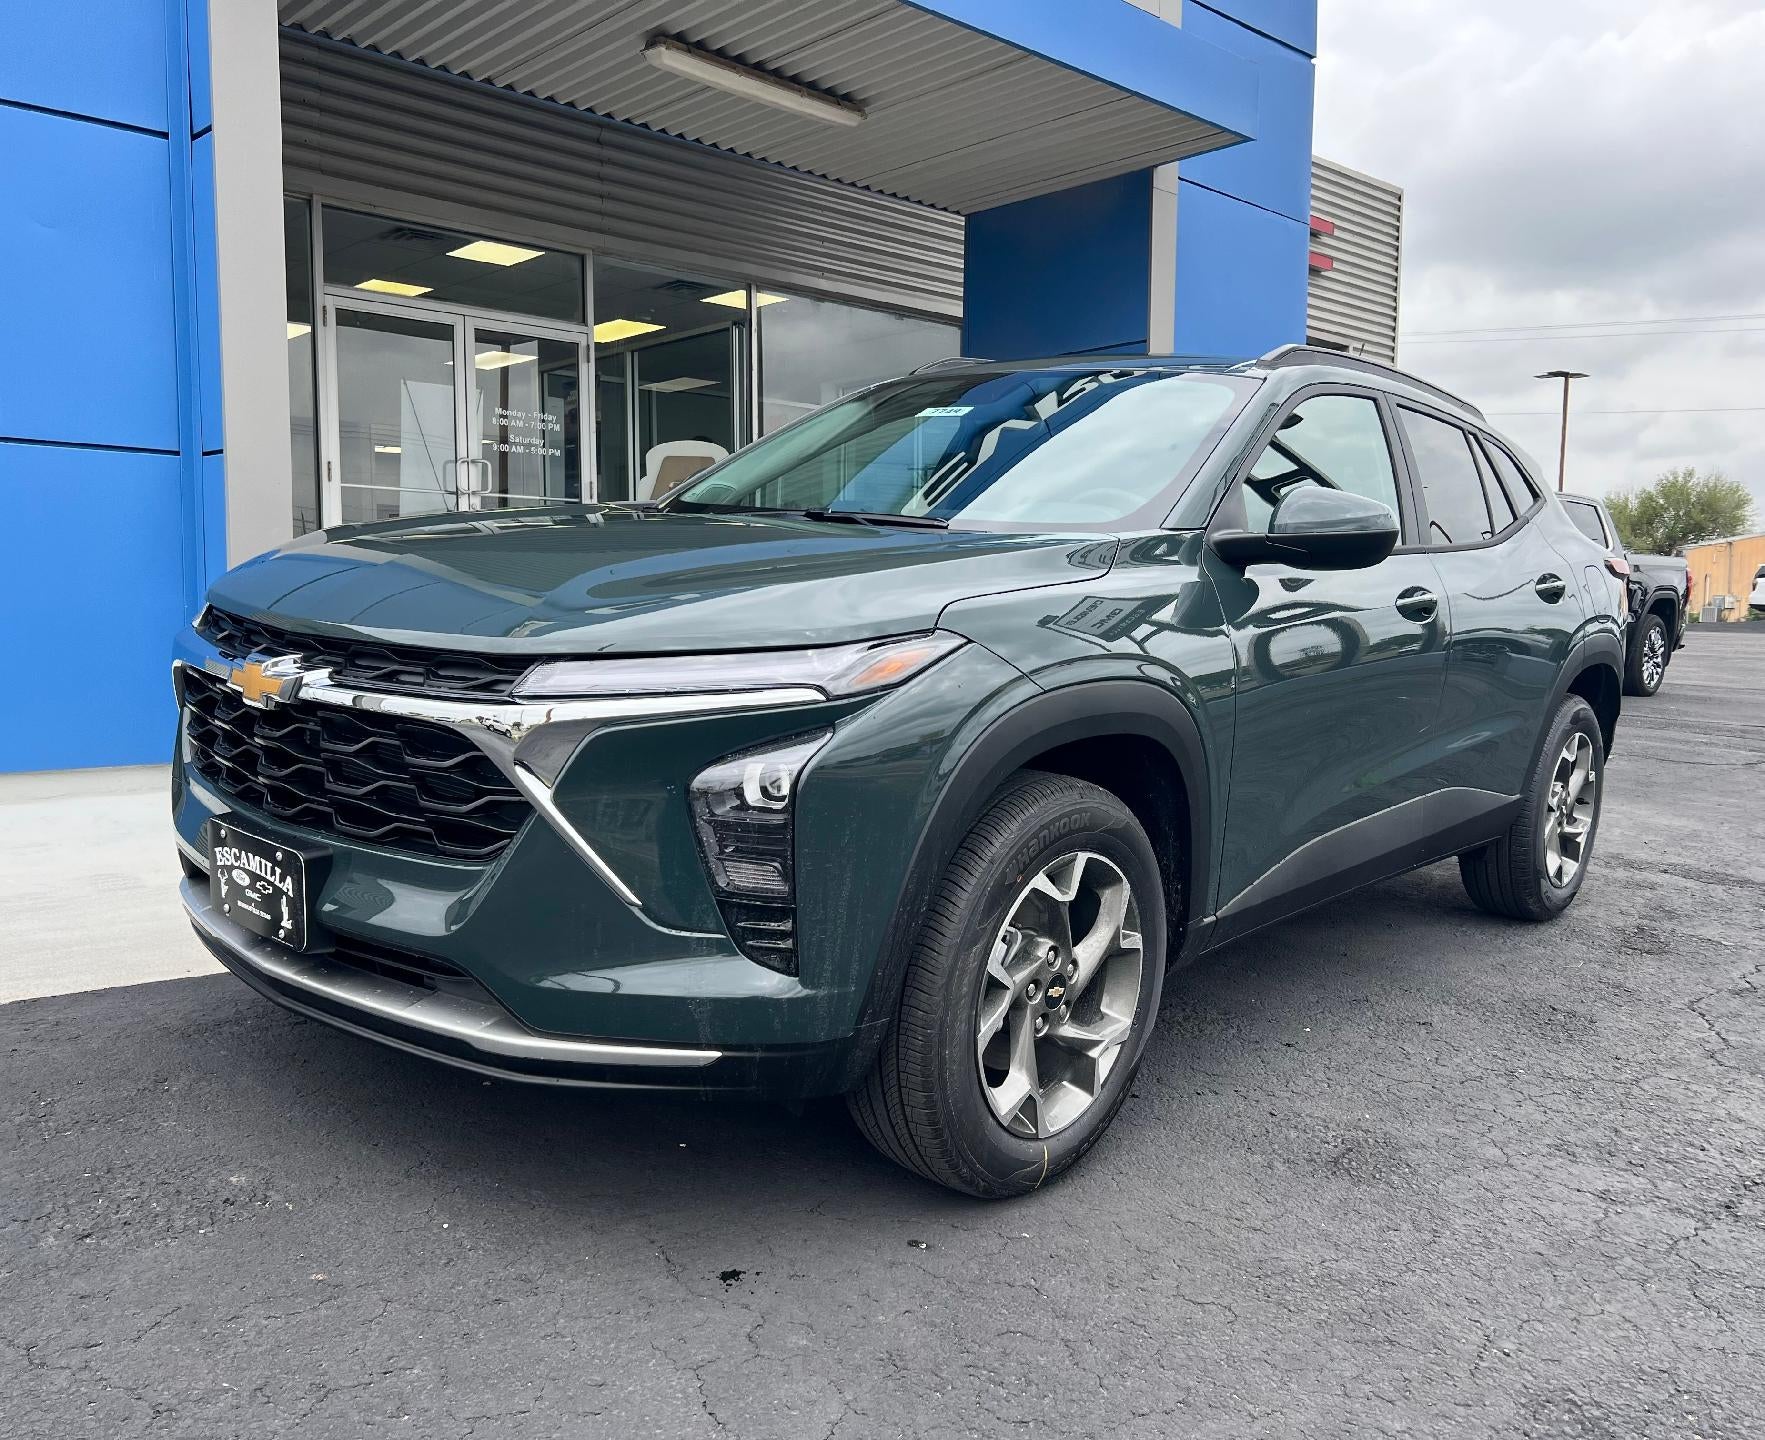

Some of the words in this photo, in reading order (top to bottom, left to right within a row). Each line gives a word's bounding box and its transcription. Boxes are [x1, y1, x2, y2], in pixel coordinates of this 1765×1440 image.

[494, 407, 526, 419] Monday
[533, 411, 557, 423] Friday
[492, 417, 509, 426] 8:00
[511, 420, 524, 428] AM
[530, 421, 546, 430] 7:00
[548, 423, 560, 432] PM
[509, 434, 545, 447] Saturday
[492, 443, 509, 452] 9:00
[511, 445, 524, 453] AM
[530, 446, 547, 455] 5:00
[548, 448, 561, 457] PM
[214, 846, 294, 898] ESCAMILLA
